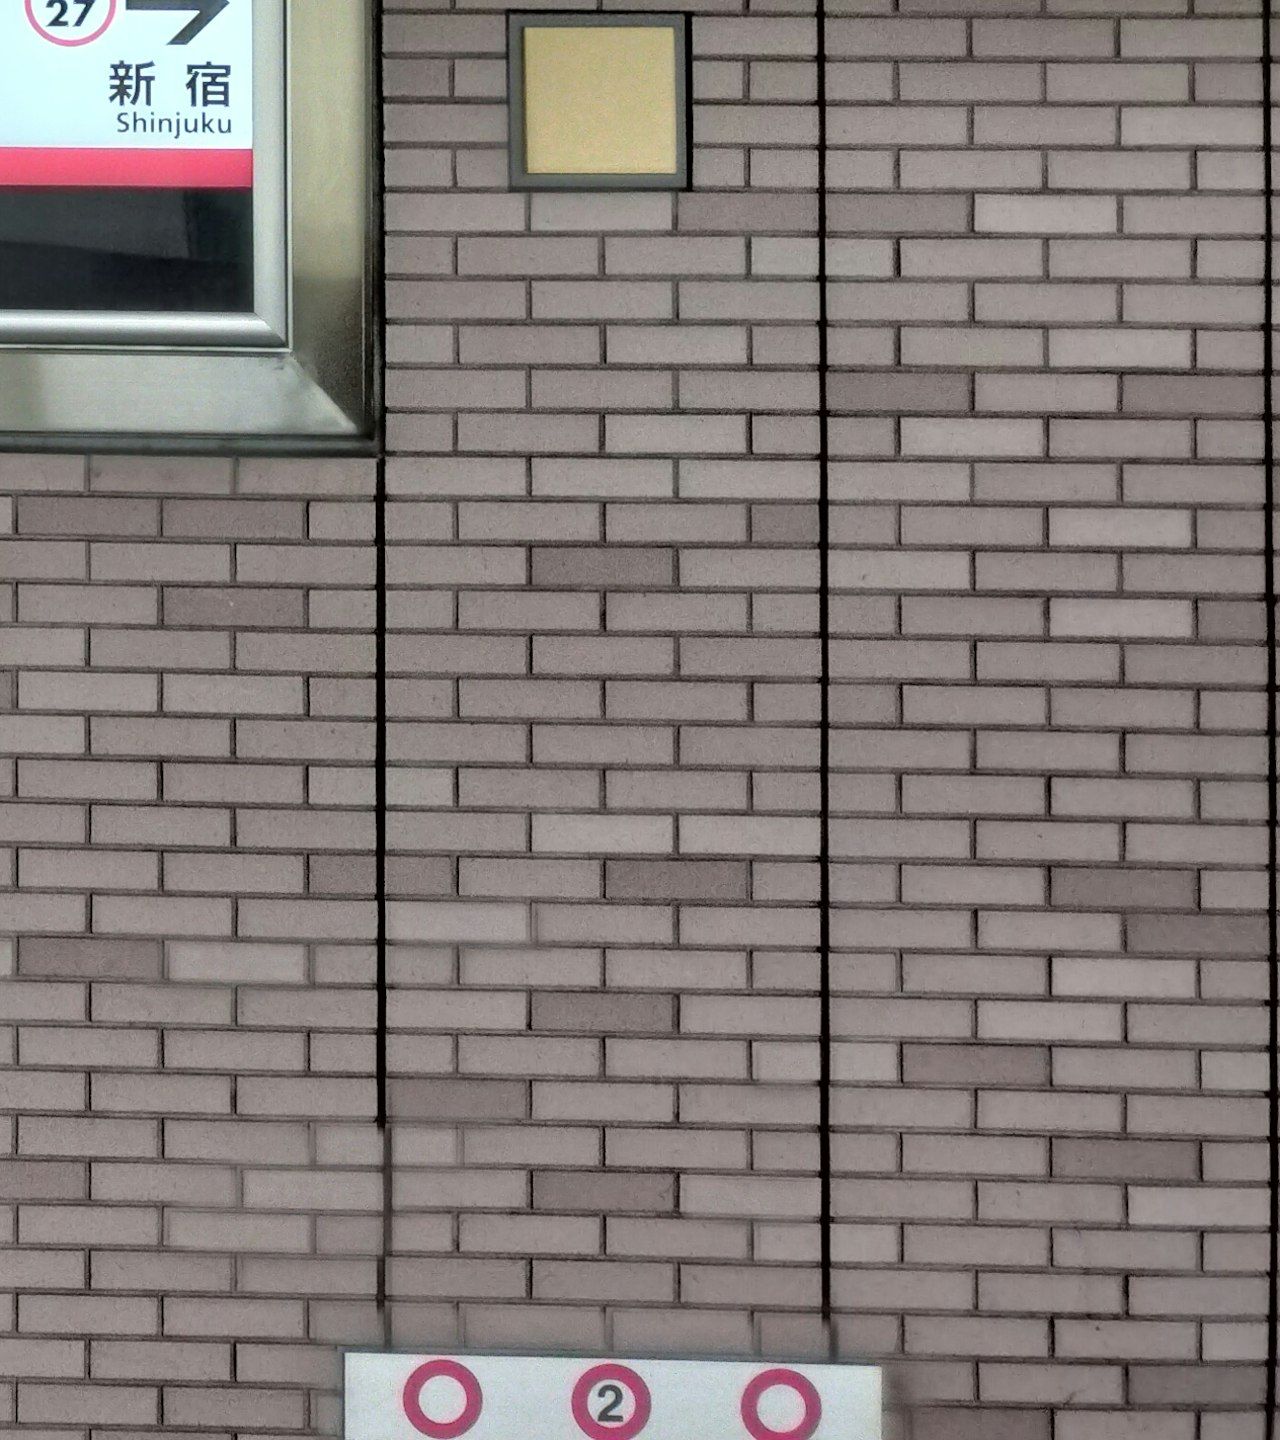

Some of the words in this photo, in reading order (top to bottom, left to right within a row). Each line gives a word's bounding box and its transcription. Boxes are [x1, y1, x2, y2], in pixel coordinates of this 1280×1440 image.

[108, 60, 231, 107] 新宿
[116, 112, 232, 139] Shinjuku
[596, 1384, 624, 1423] 2
